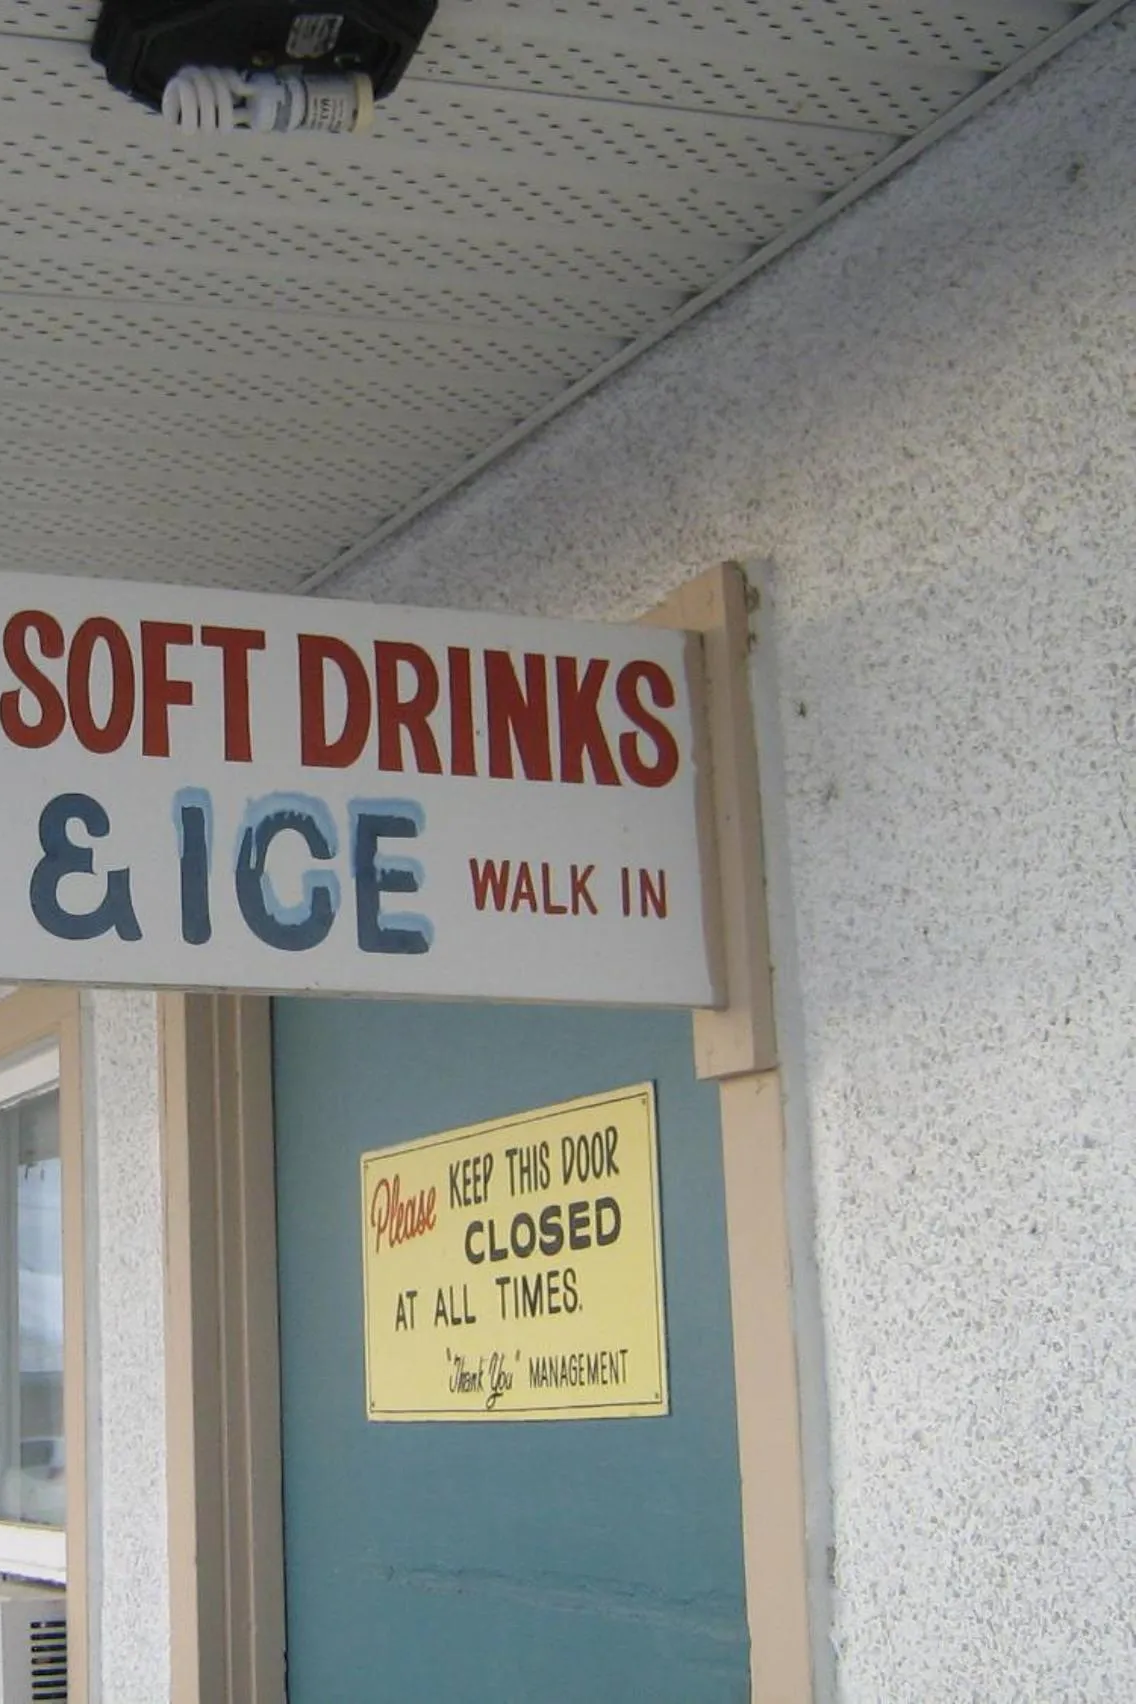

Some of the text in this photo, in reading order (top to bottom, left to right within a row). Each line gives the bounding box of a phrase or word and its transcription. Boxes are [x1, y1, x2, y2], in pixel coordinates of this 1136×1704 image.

[297, 633, 679, 788] DRINKS
[29, 786, 435, 955] & ICE
[469, 857, 668, 919] WALK IN
[371, 1126, 620, 1253] Please KEEP THIS DOOR
[464, 1196, 622, 1265] CLOSED
[395, 1268, 583, 1332] AT ALL TIMES.
[529, 1349, 628, 1389] MANAGEMENT
